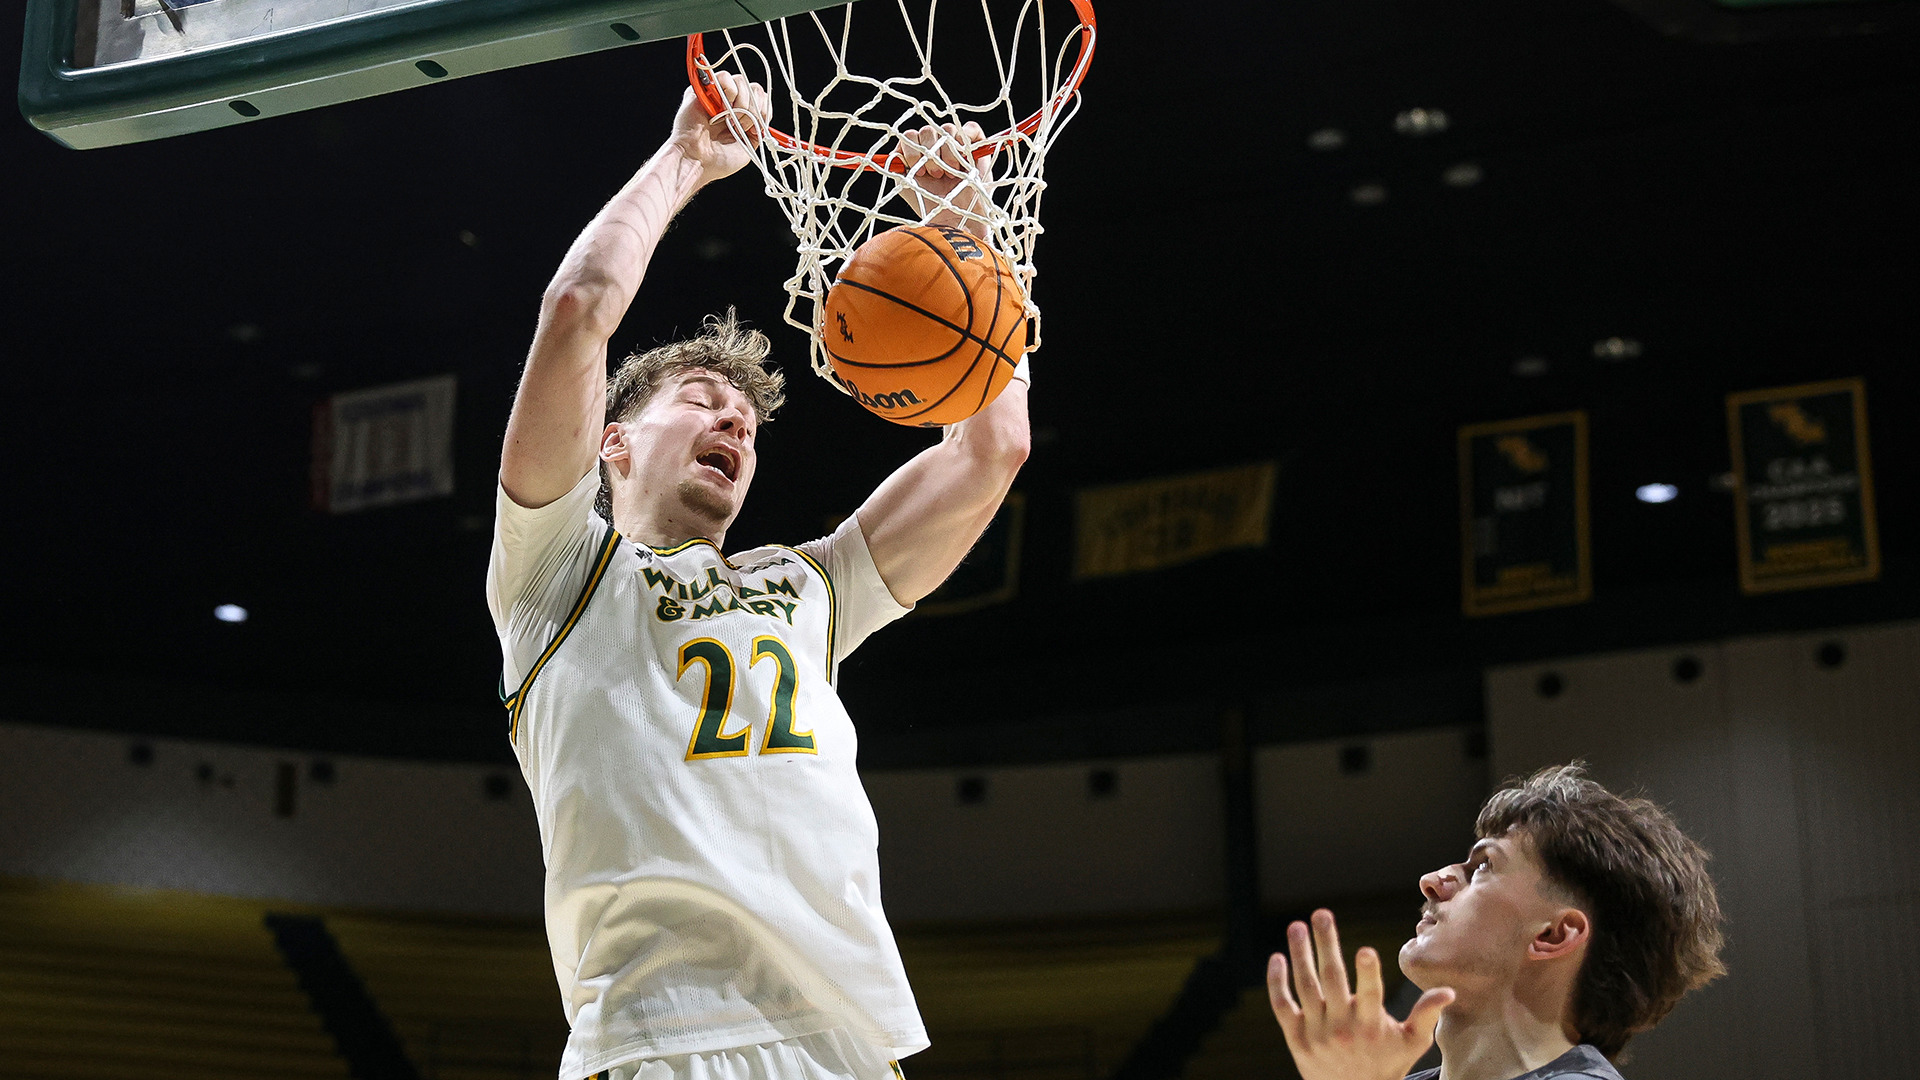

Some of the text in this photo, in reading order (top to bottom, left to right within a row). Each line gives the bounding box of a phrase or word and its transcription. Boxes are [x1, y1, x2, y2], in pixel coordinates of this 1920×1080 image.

[639, 567, 802, 601] WILLAM
[656, 594, 799, 627] & MARY
[677, 635, 818, 762] 22
